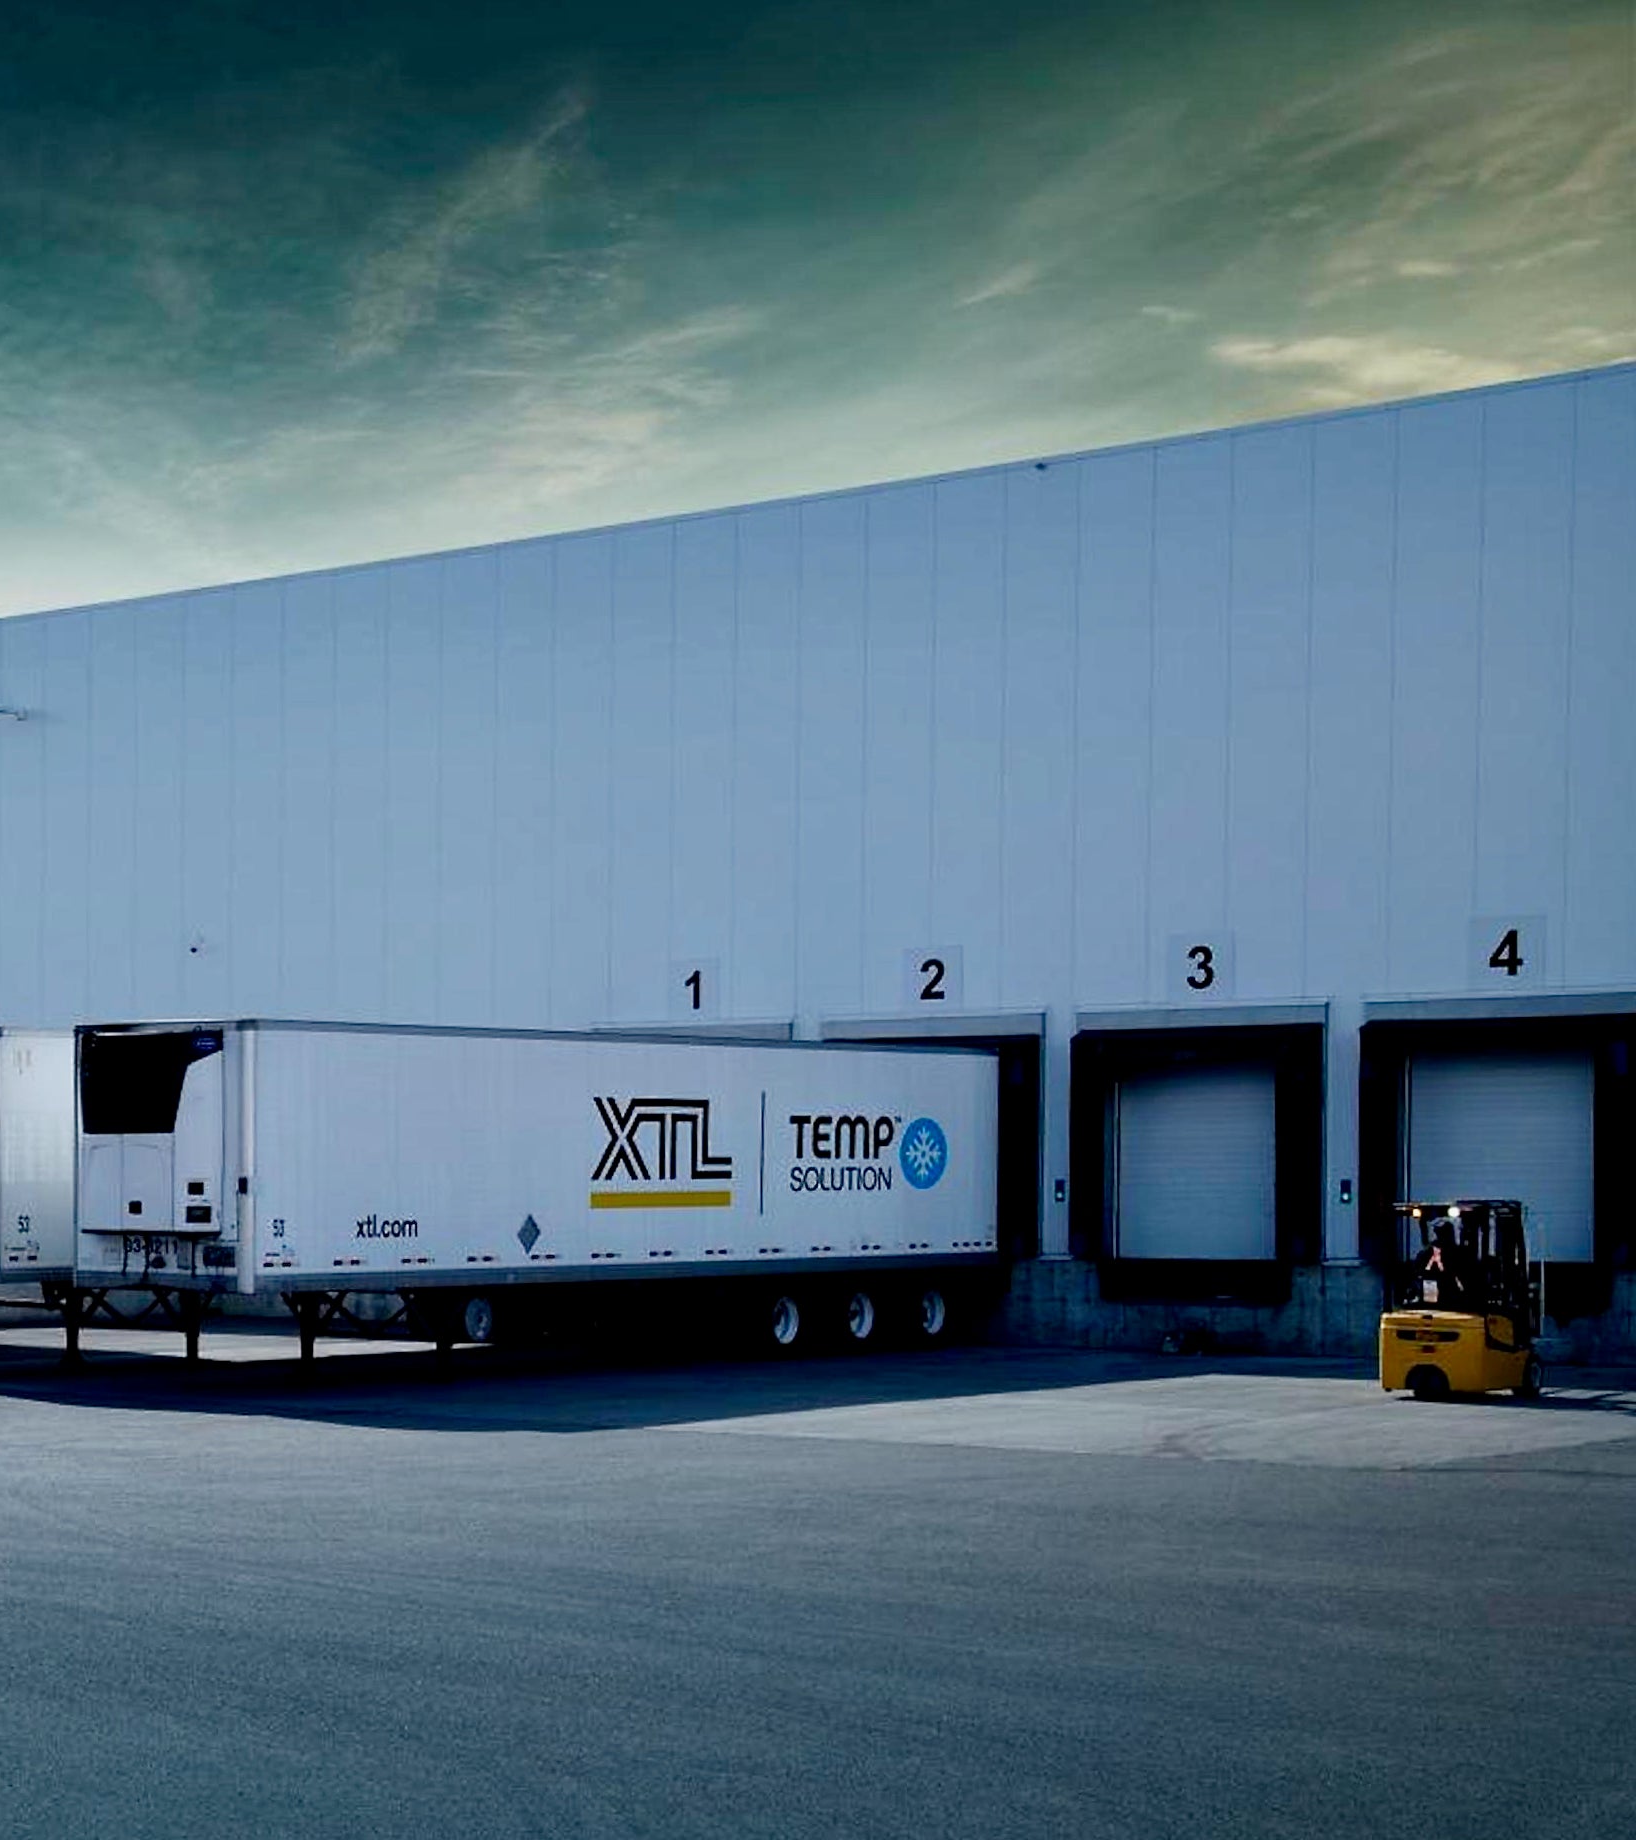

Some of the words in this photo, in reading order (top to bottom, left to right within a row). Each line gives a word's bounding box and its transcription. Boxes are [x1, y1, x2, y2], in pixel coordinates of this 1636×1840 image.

[1187, 945, 1213, 990] 3
[1489, 929, 1523, 976] 4
[684, 970, 700, 1010] 1
[920, 958, 945, 1000] 2
[591, 1096, 732, 1180] XTL
[789, 1115, 894, 1159] TEMP
[789, 1166, 892, 1191] SOLUTION
[356, 1213, 418, 1238] xtl.com
